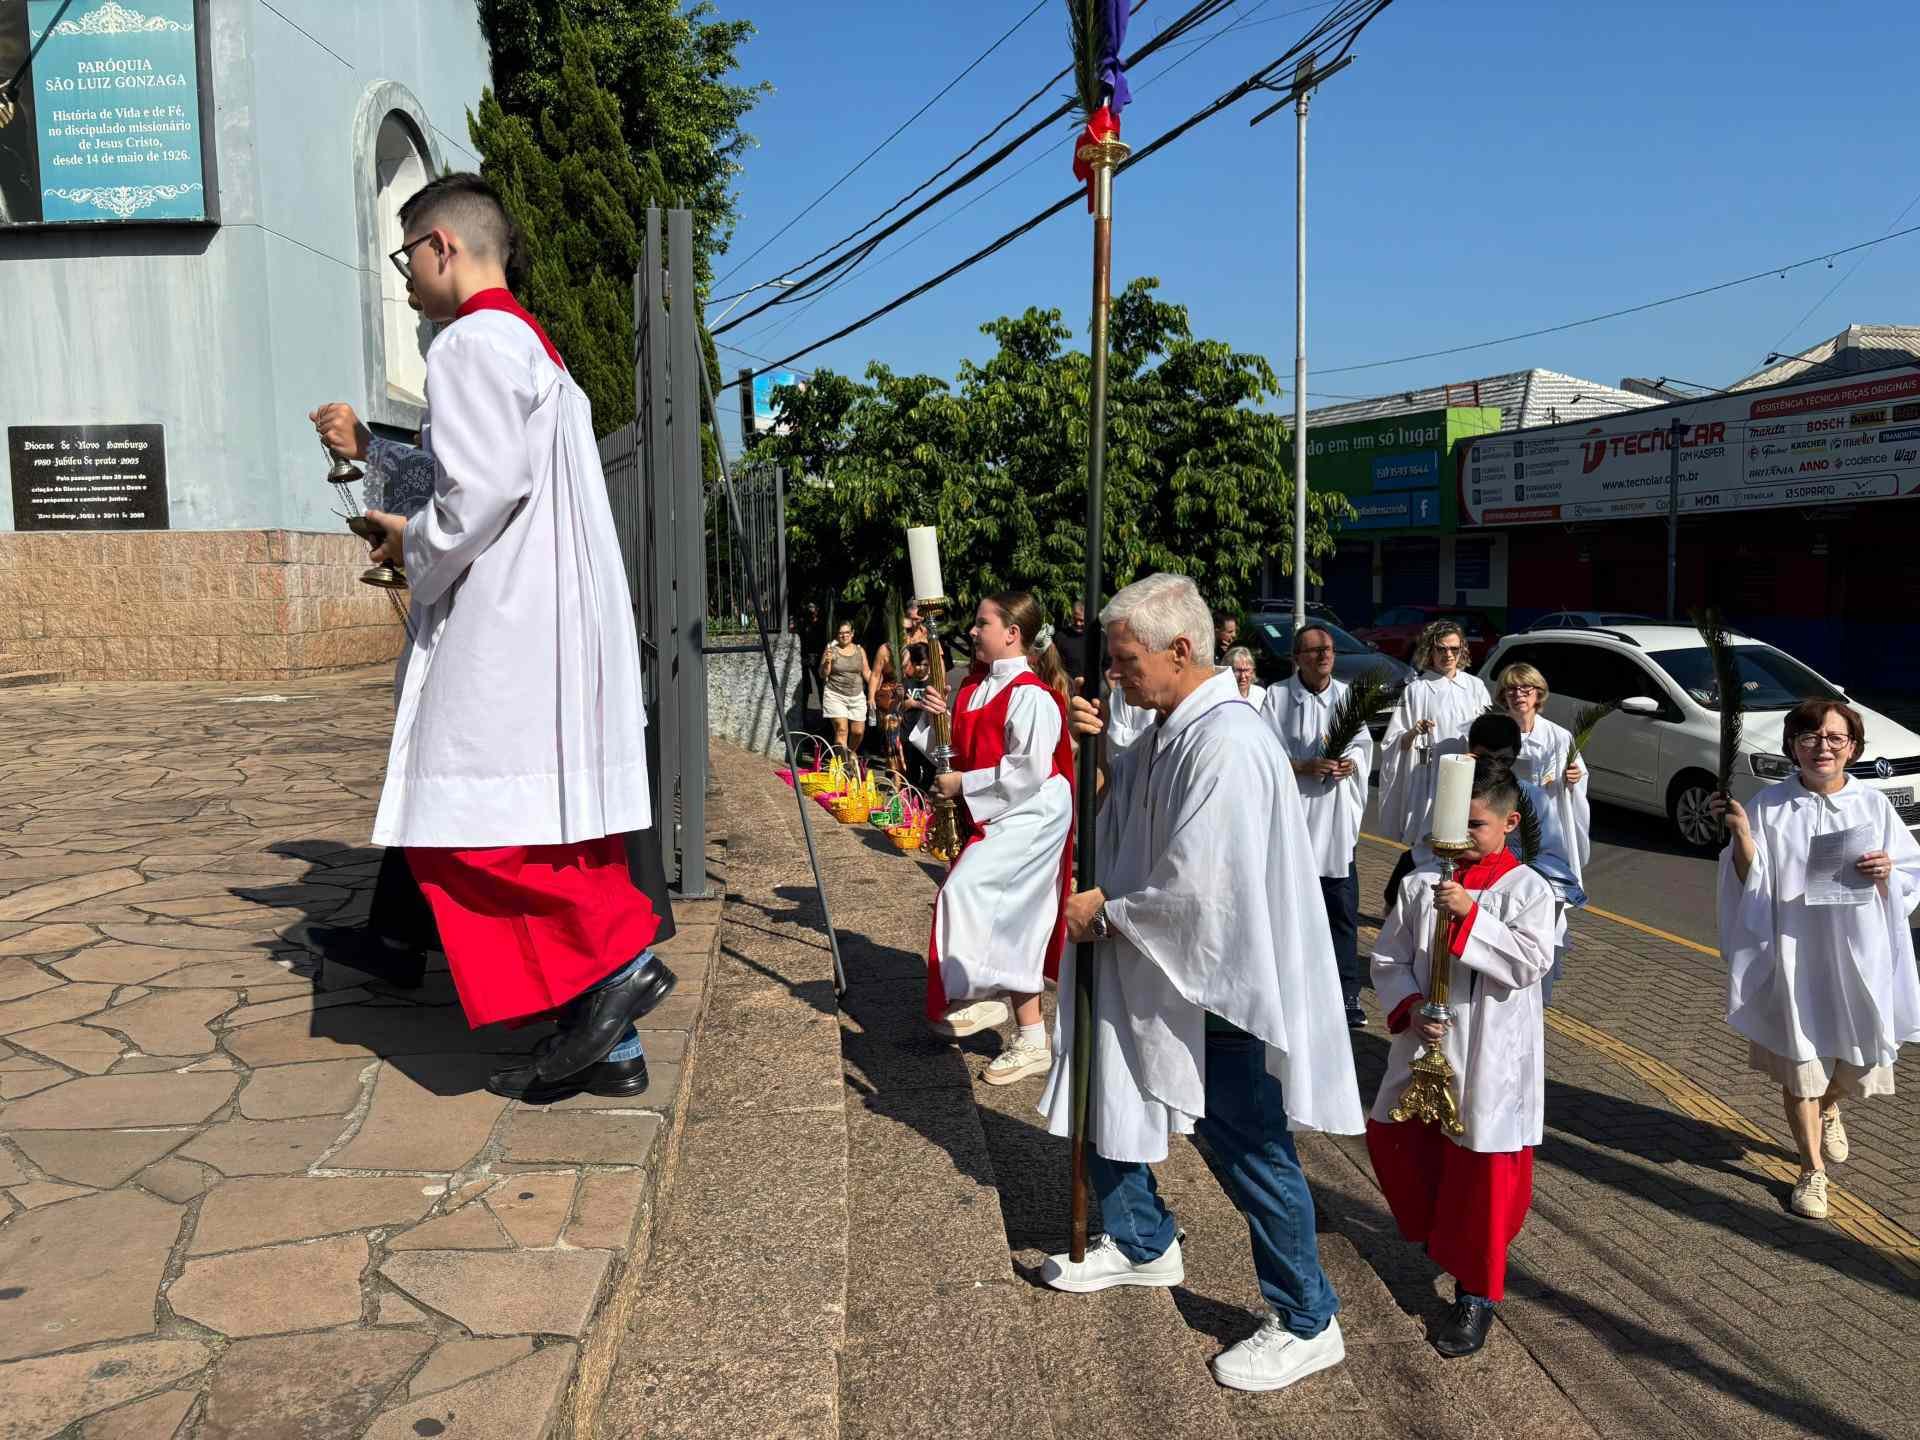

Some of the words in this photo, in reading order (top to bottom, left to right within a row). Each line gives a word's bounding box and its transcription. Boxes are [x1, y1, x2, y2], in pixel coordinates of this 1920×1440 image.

[78, 58, 153, 73] PARÓQUIA
[45, 77, 74, 91] SÃO
[78, 78, 111, 90] LUIZ
[114, 74, 187, 89] GONZAGA
[53, 108, 97, 121] História
[99, 108, 112, 119] de
[115, 106, 141, 118] Vida
[143, 109, 150, 117] e
[152, 106, 165, 117] de
[168, 104, 185, 117] Fé,
[48, 127, 63, 137] no
[64, 123, 126, 139] discipulado
[129, 120, 191, 133] missionário
[78, 139, 92, 150] de
[94, 138, 123, 150] Jesus
[126, 136, 163, 149] Cristo,
[53, 155, 83, 166] desde
[86, 154, 99, 164] 14
[101, 153, 114, 164] de
[117, 152, 144, 163] maio
[146, 151, 160, 162] de
[1806, 392, 1840, 405] TÉCNICA
[1842, 387, 1869, 401] PEÇAS
[1871, 379, 1917, 396] ORIGINAIS
[1807, 416, 1845, 433] BOSCH
[24, 440, 55, 451] Diocese
[60, 440, 70, 450] de
[77, 441, 100, 450] Novo
[106, 439, 148, 451] Hamburgo
[1307, 439, 1324, 456] do
[1328, 439, 1349, 453] em
[1353, 435, 1374, 449] um
[1378, 428, 1394, 446] só
[1399, 427, 1440, 447] lugar
[1694, 446, 1725, 460] KASPER
[1844, 453, 1888, 467] cadence
[54, 456, 82, 468] Jubileu
[84, 455, 93, 465] de
[95, 457, 116, 466] prata
